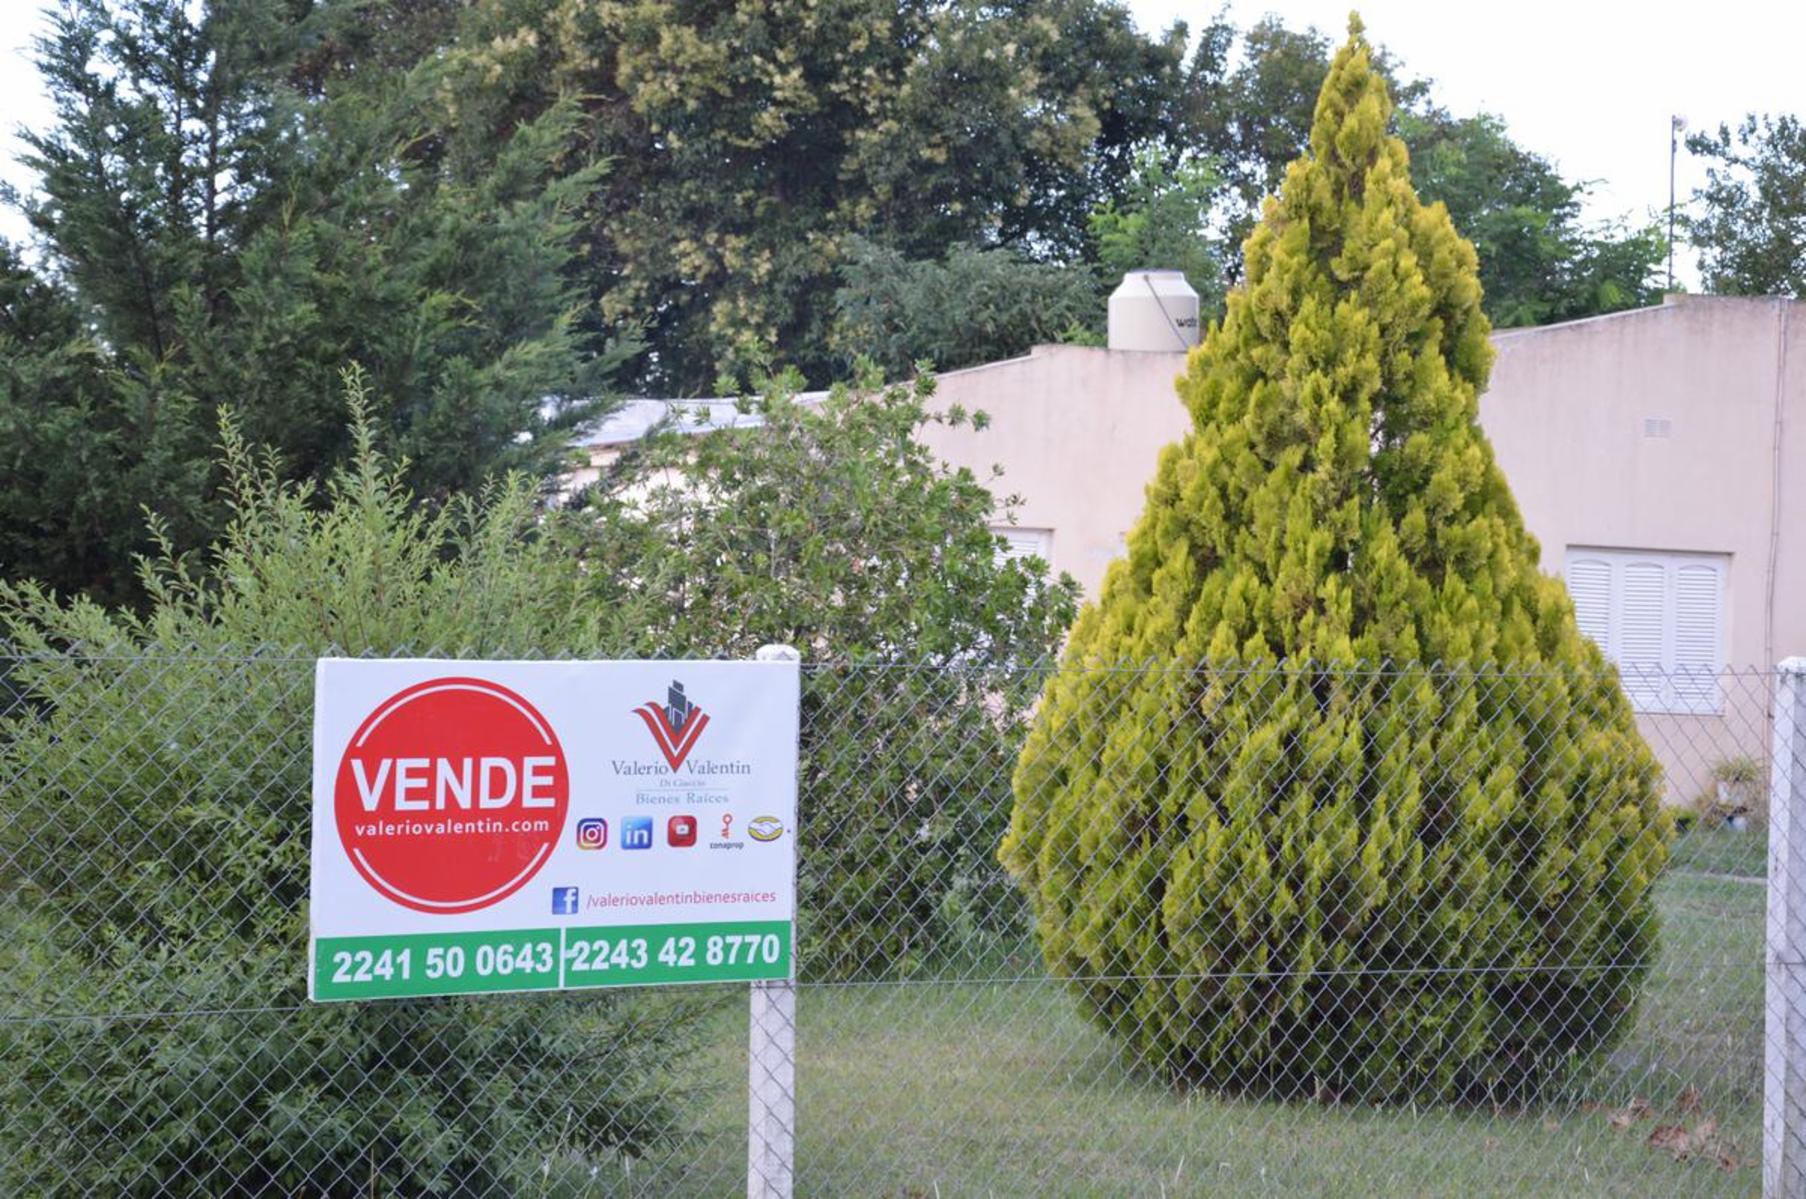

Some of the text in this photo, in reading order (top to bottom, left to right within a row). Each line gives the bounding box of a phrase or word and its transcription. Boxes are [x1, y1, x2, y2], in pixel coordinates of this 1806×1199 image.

[612, 759, 751, 776] Valerio Valentin
[350, 756, 556, 812] VENDE
[636, 793, 680, 805] Bienes
[355, 818, 549, 837] valeriovalentin.com
[625, 824, 649, 845] in
[658, 936, 696, 967] 42
[706, 934, 781, 966] 8770
[332, 942, 553, 983] 2241 50 0643
